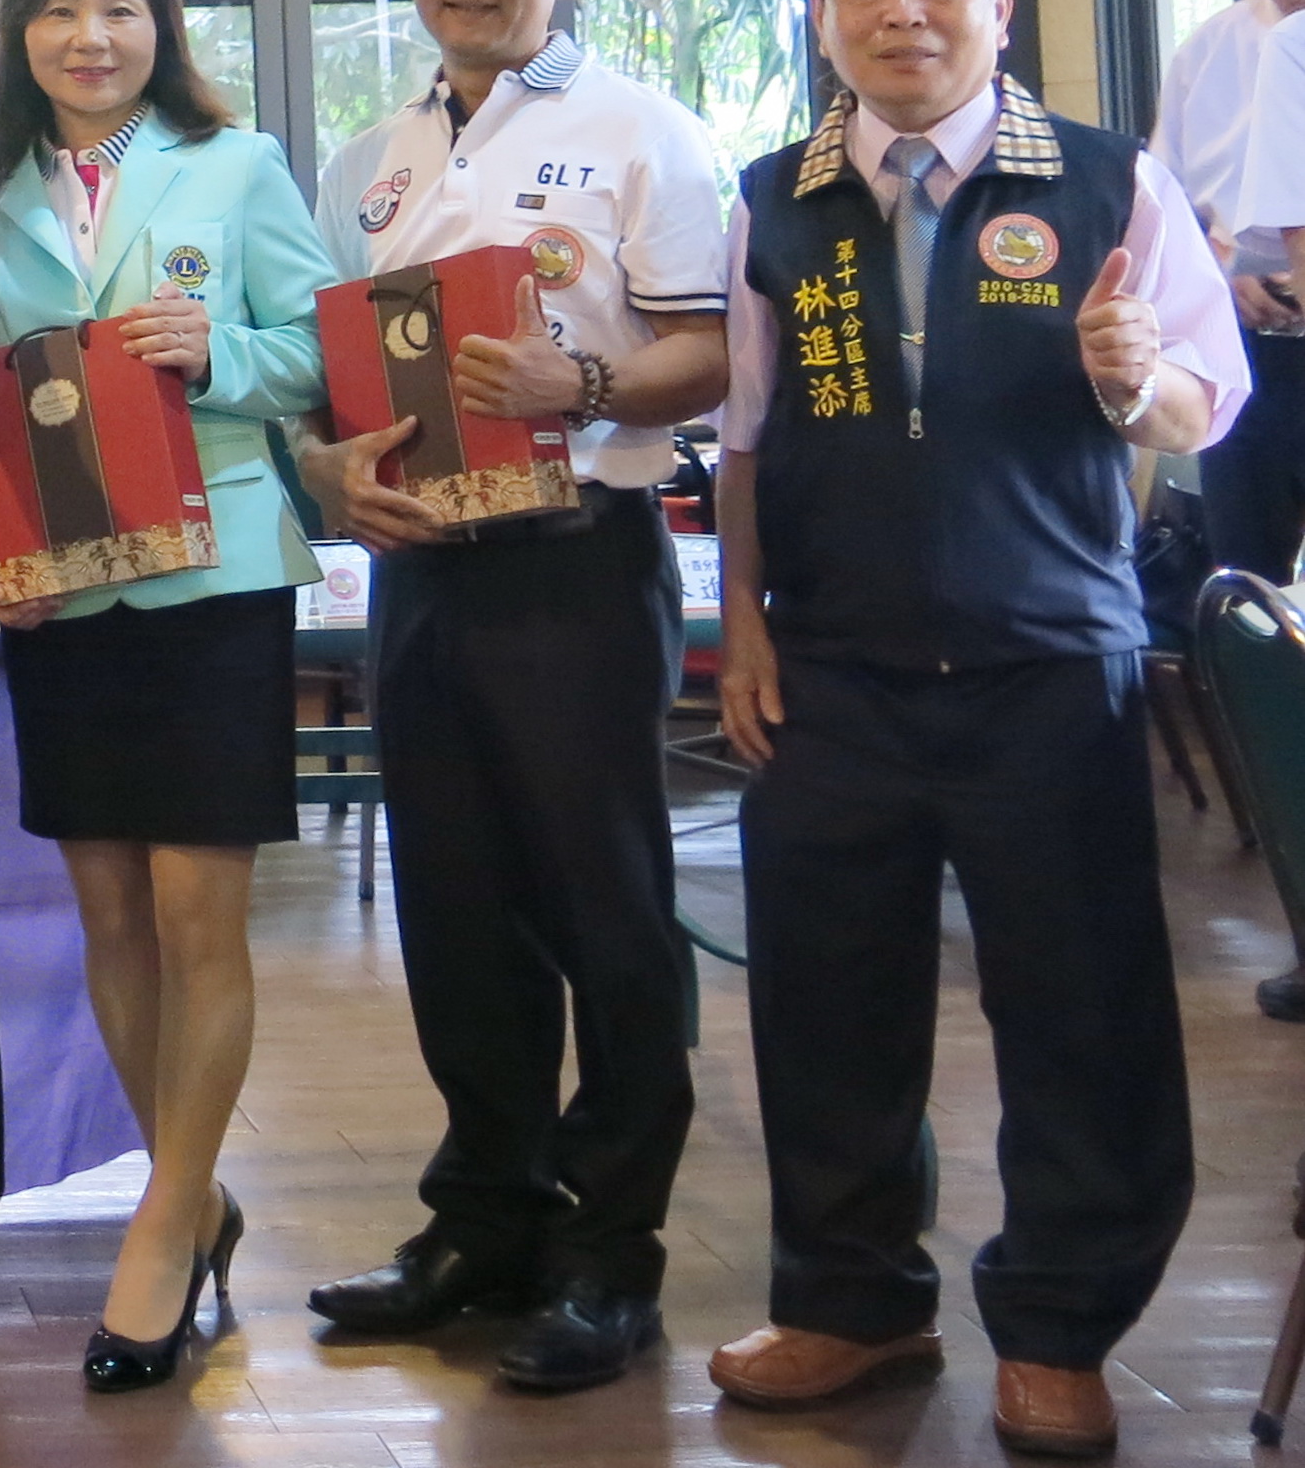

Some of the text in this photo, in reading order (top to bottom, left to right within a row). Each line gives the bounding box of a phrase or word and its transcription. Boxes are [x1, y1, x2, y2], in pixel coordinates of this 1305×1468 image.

[793, 274, 849, 418] 林進添
[834, 238, 873, 417] 第十四分區主席
